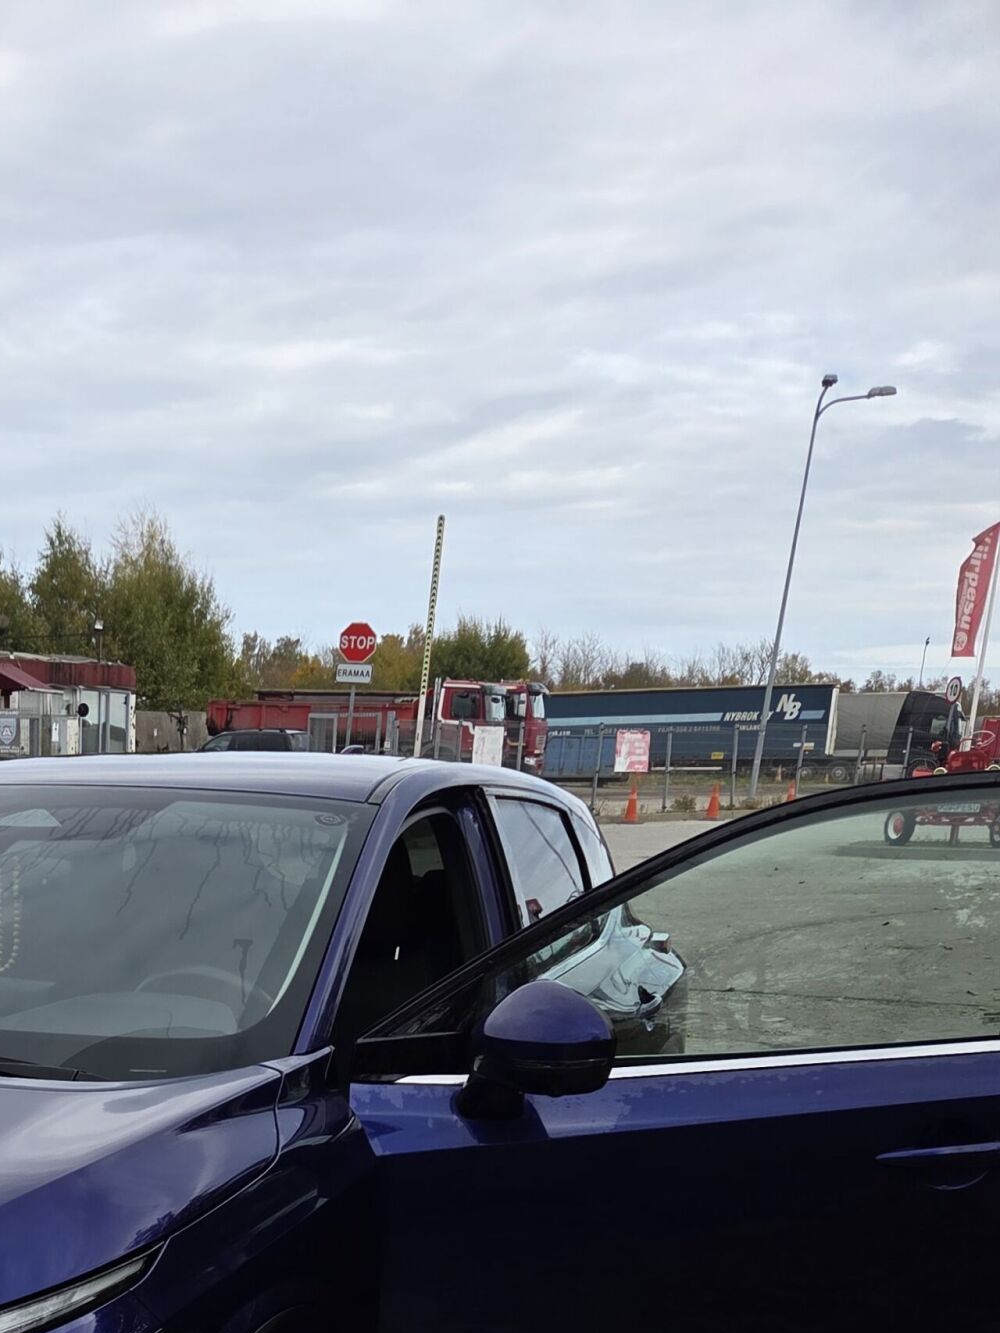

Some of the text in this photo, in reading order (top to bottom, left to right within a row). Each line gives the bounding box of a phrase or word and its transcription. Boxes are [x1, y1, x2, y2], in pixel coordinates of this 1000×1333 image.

[340, 635, 375, 650] STOP
[337, 668, 370, 678] ERAMAA
[949, 683, 959, 697] 10
[723, 711, 760, 721] NYBROK
